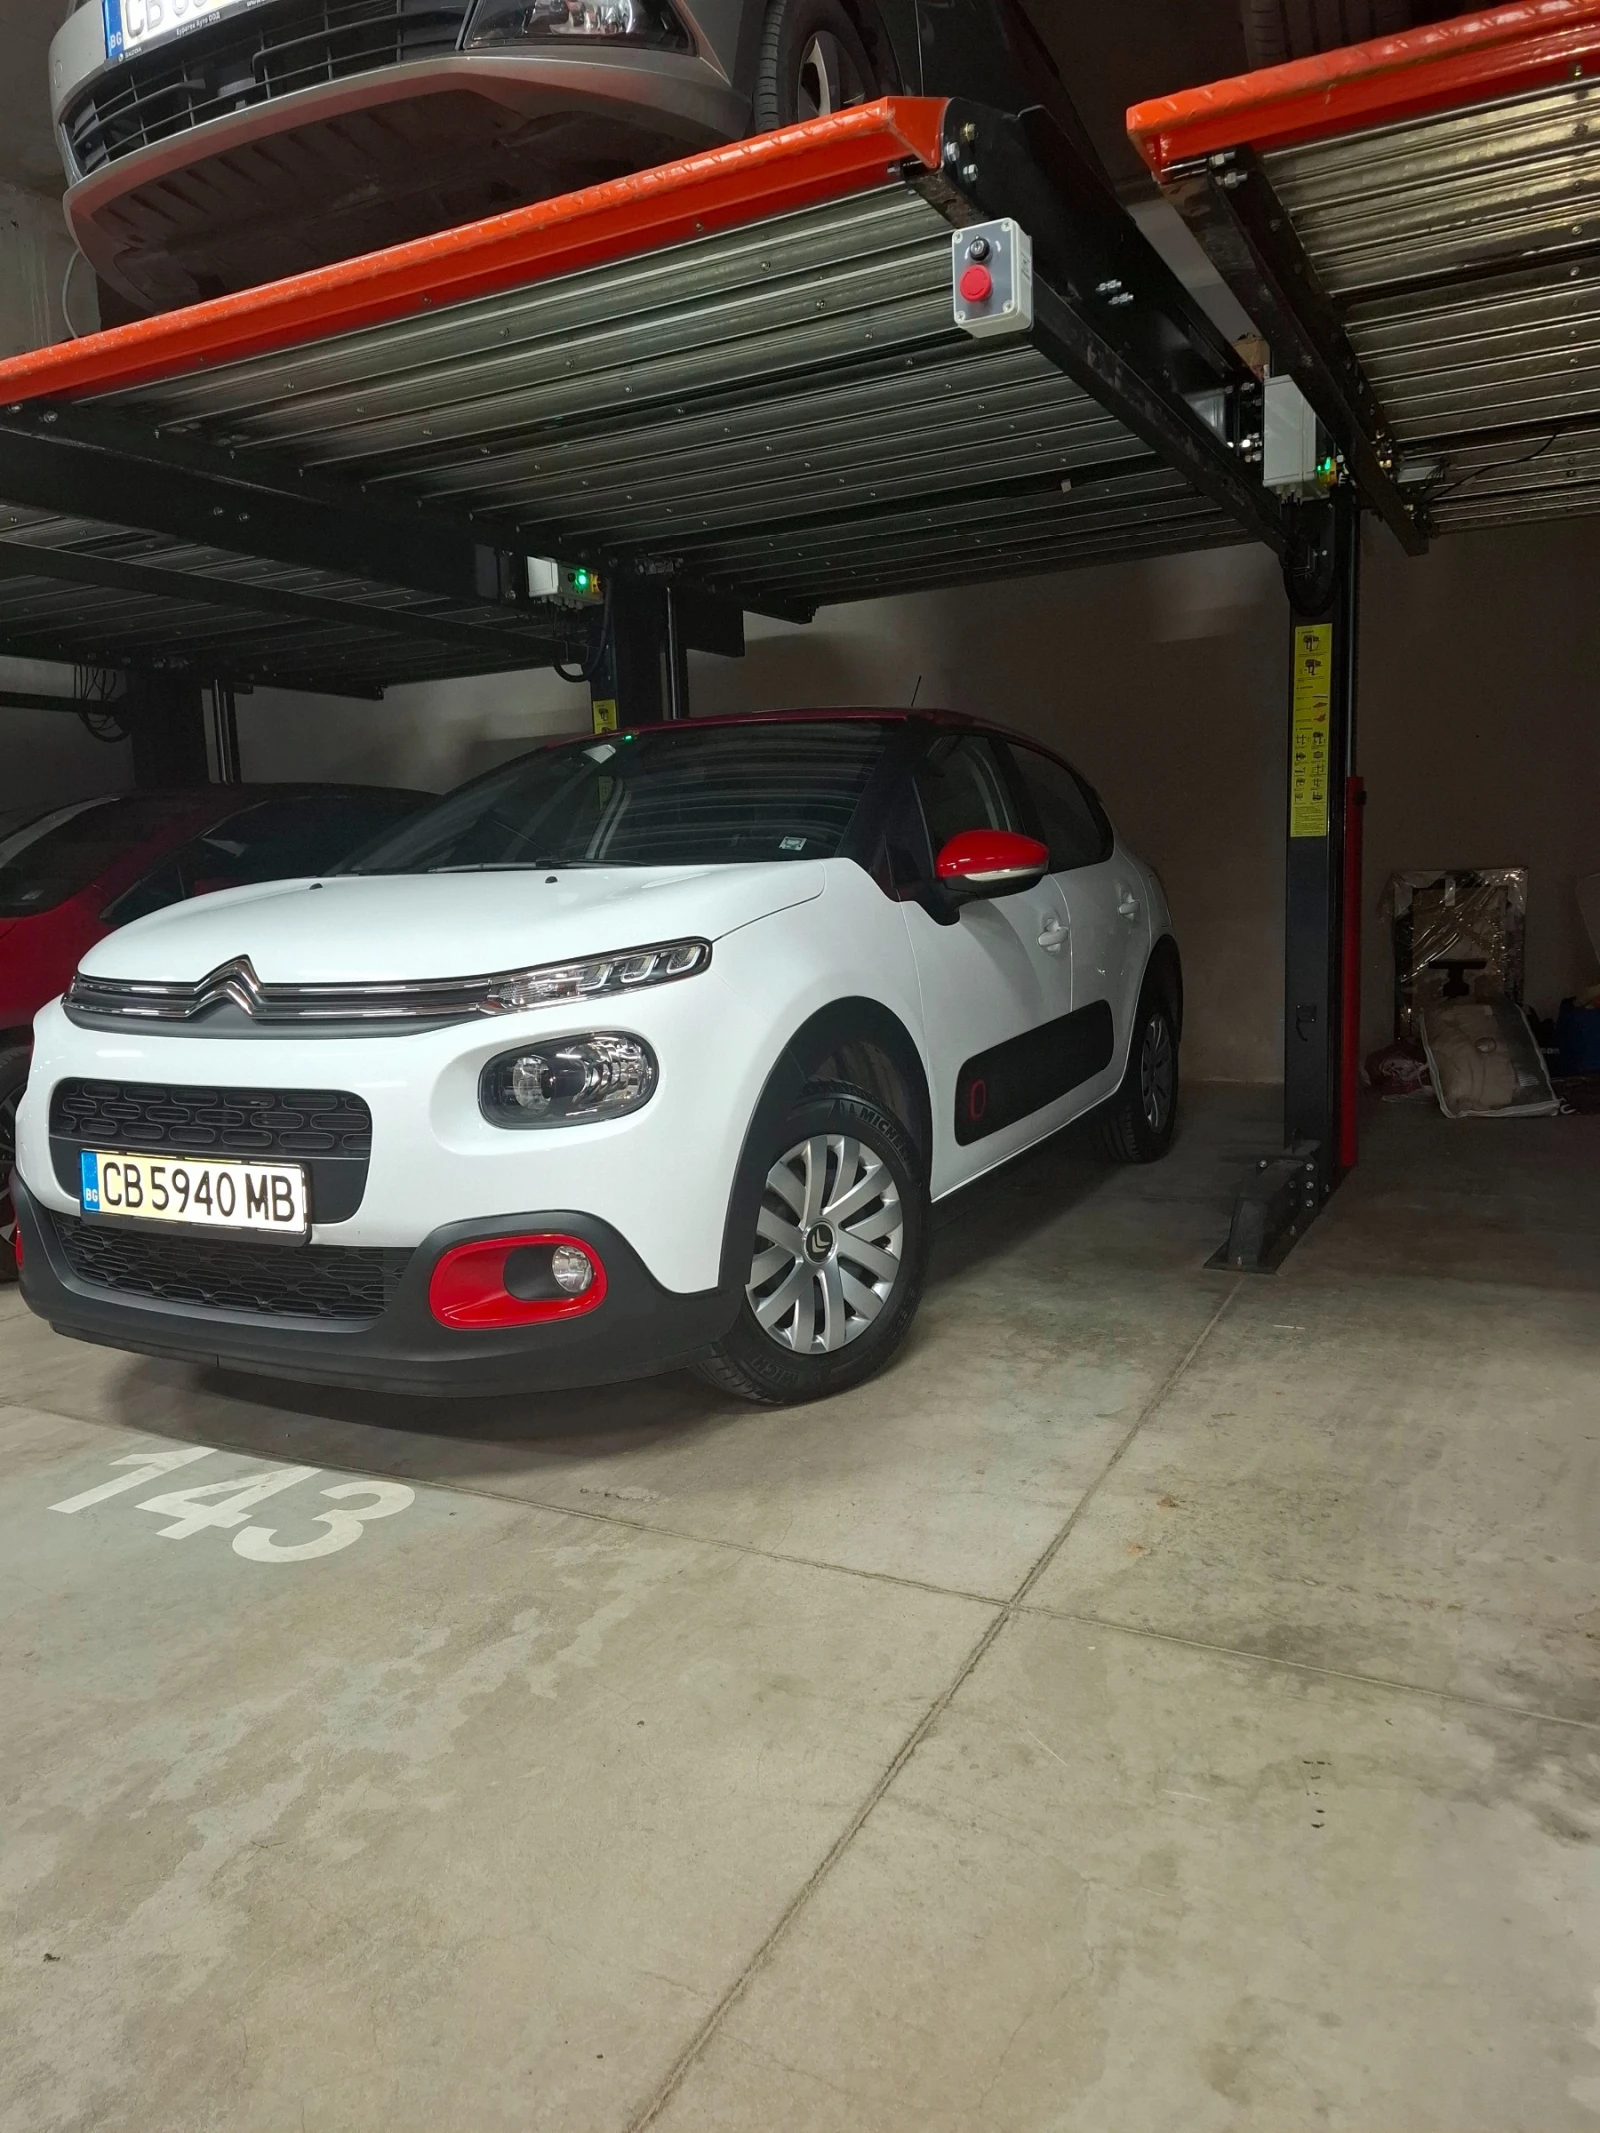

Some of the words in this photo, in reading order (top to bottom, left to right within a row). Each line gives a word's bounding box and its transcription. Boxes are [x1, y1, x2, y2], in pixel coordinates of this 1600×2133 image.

[110, 31, 122, 49] BG
[85, 1187, 98, 1202] BG
[103, 1161, 143, 1209] CB
[150, 1165, 236, 1217] 5940
[245, 1173, 295, 1223] MB
[46, 1445, 416, 1563] 143
